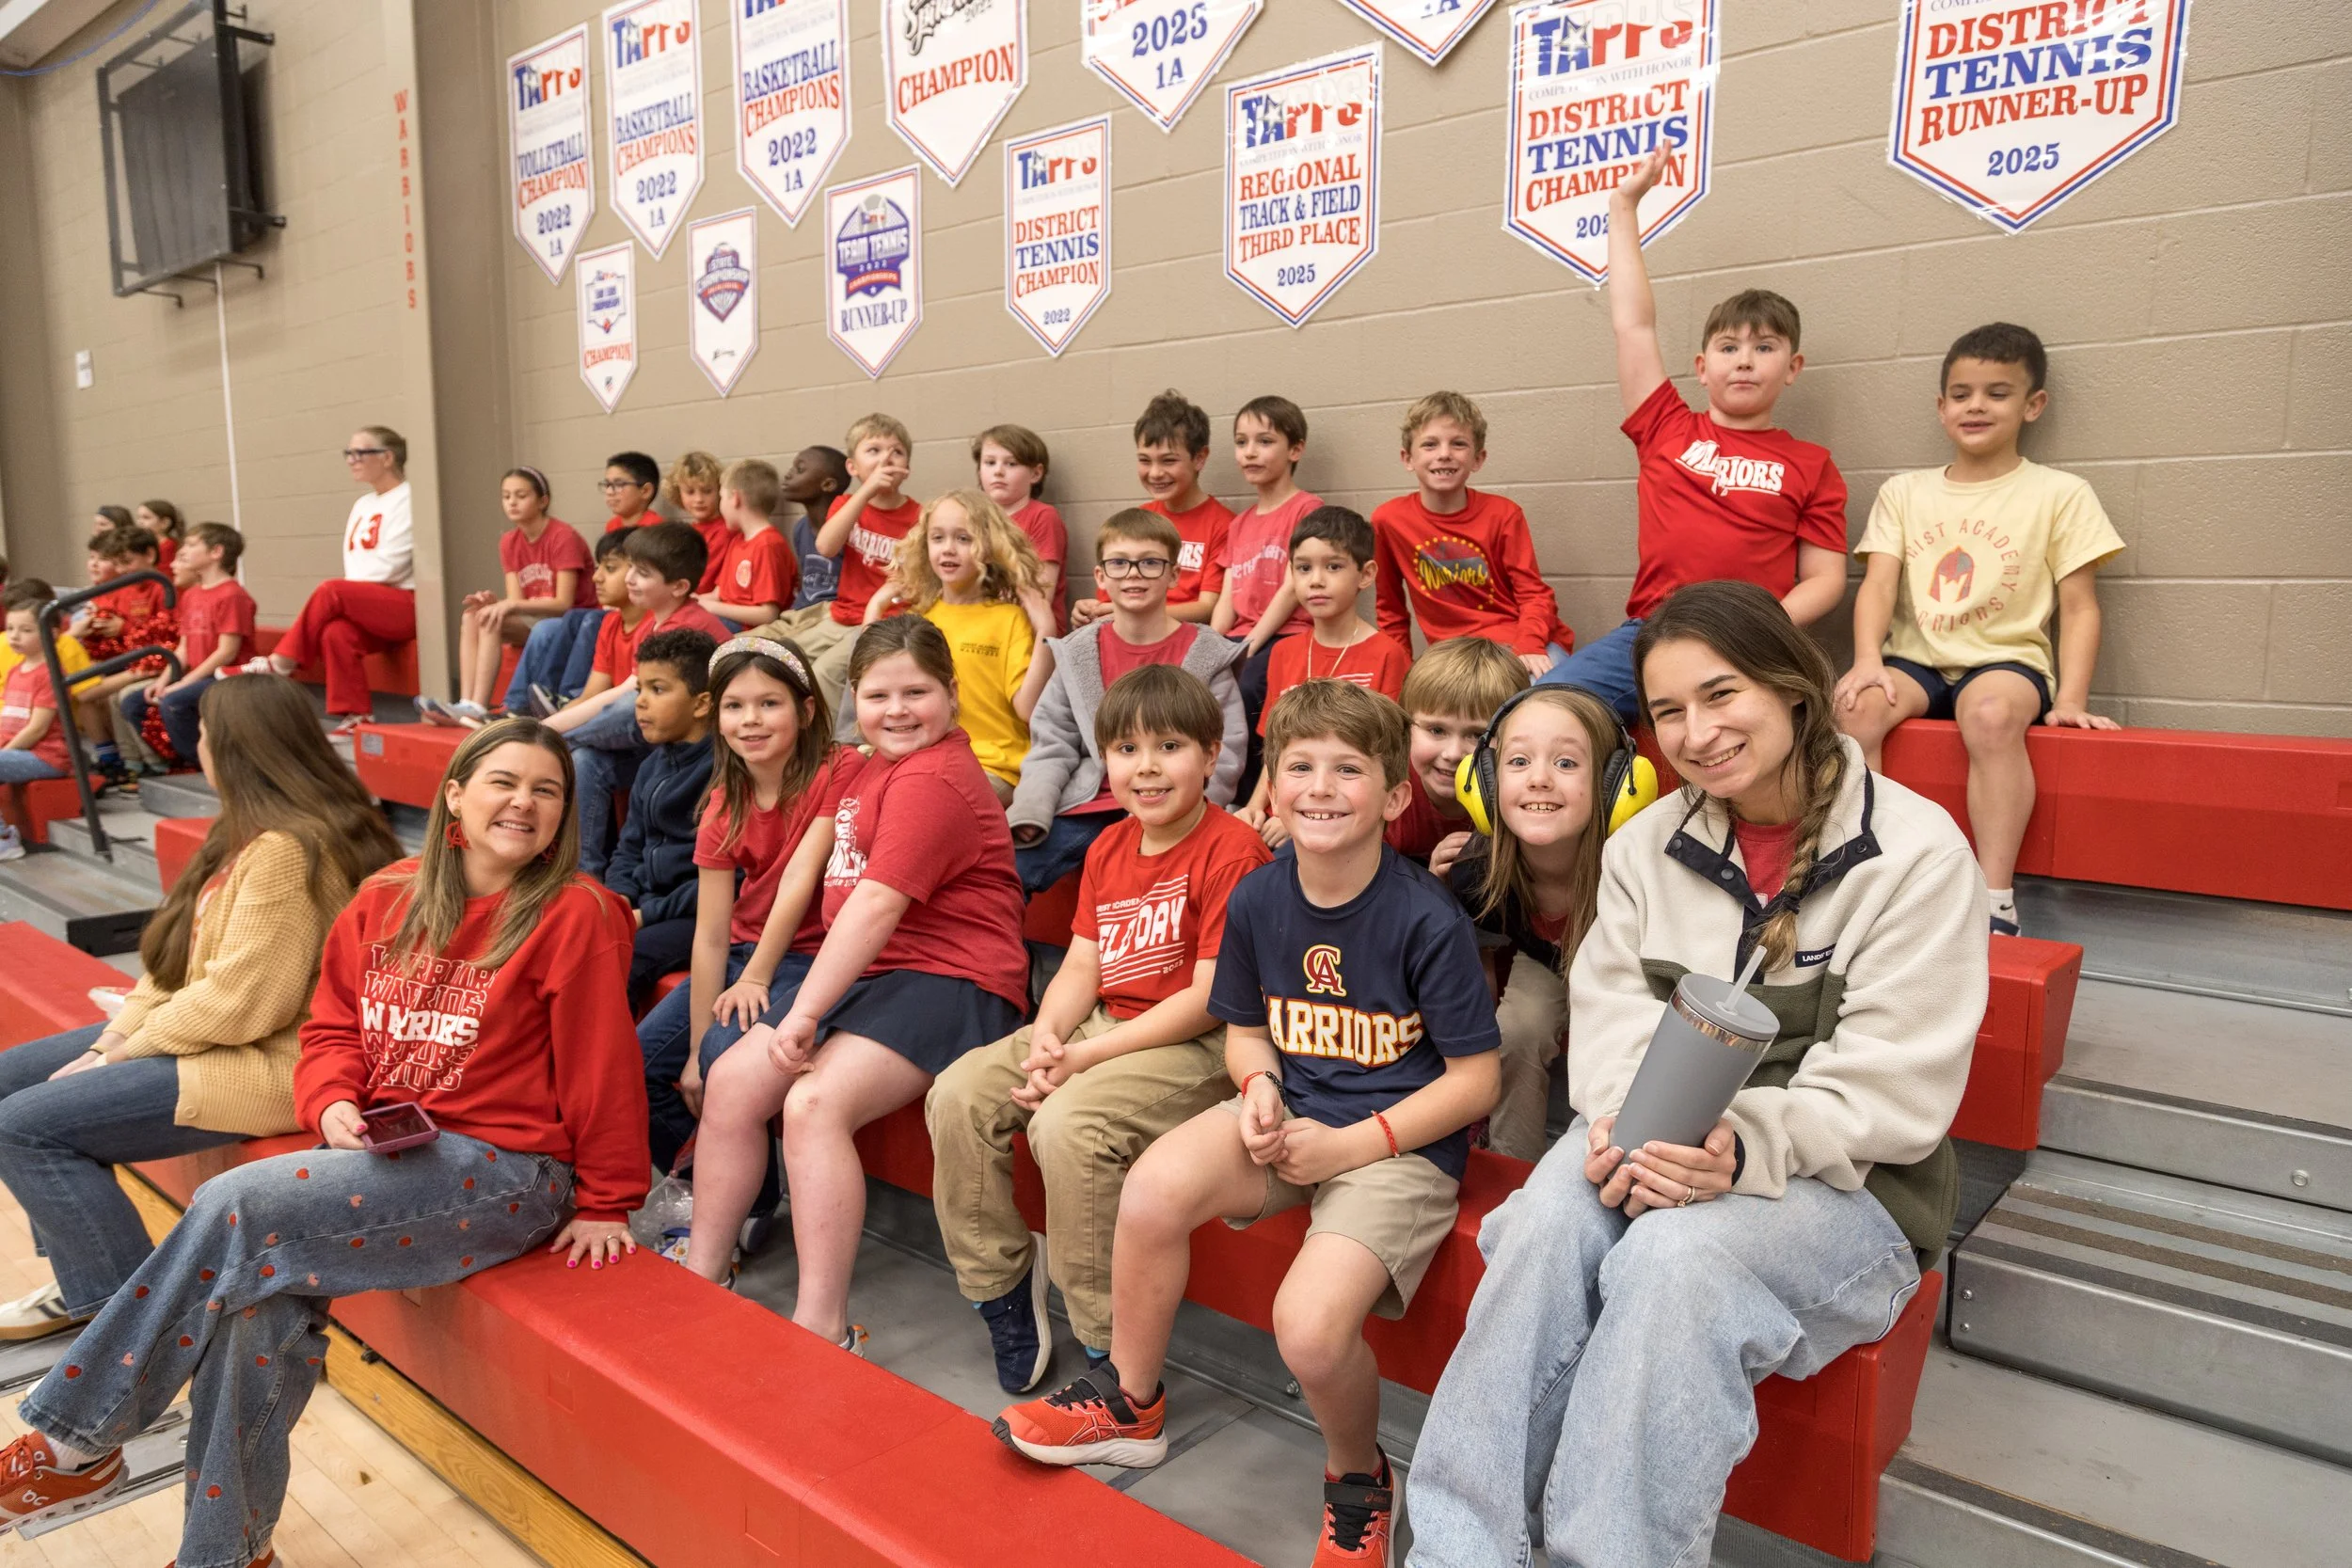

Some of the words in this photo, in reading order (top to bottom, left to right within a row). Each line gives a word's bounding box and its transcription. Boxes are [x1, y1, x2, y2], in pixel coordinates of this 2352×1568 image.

[1132, 2, 1209, 58] 2025
[743, 40, 839, 103] BASKETBALL
[898, 42, 1016, 114] CHAMPION
[1155, 56, 1184, 90] 1A
[1924, 27, 2153, 100] TENNIS
[615, 93, 694, 144] BASKETBALL
[744, 73, 840, 137] CHAMPIONS
[1528, 79, 1690, 141] DISTRICT
[1917, 73, 2149, 147] RUNNER-UP
[517, 133, 584, 179] VOLLEYBALL
[615, 123, 696, 176] CHAMPIONS
[768, 127, 817, 166] 2022
[1527, 115, 1689, 174] TENNIS
[1986, 143, 2060, 177] 2025
[518, 161, 586, 210] CHAMPION
[636, 170, 677, 203] 2022
[784, 169, 803, 193] 1A
[1239, 153, 1361, 201] REGIONAL
[1526, 153, 1688, 213] CHAMPN
[536, 203, 572, 235] 2022
[649, 207, 666, 229] 1A
[1015, 205, 1100, 245] DISTRICT
[1240, 196, 1290, 230] TRACK
[1295, 194, 1306, 221] &
[1311, 184, 1361, 218] FIELD
[549, 238, 564, 258] 1A
[1016, 232, 1100, 270] TENNIS
[1239, 228, 1295, 263] THIRD
[1299, 216, 1360, 246] PLACE
[1016, 261, 1100, 299] CHAMPION
[1277, 263, 1316, 287] 2025
[841, 298, 908, 333] RUNNER-UP
[1042, 308, 1072, 325] 2022
[583, 341, 633, 370] CHAMPION
[1959, 518, 2021, 593] ACADEMY
[1135, 895, 1187, 952] DAY
[1265, 994, 1424, 1068] ARRIORS
